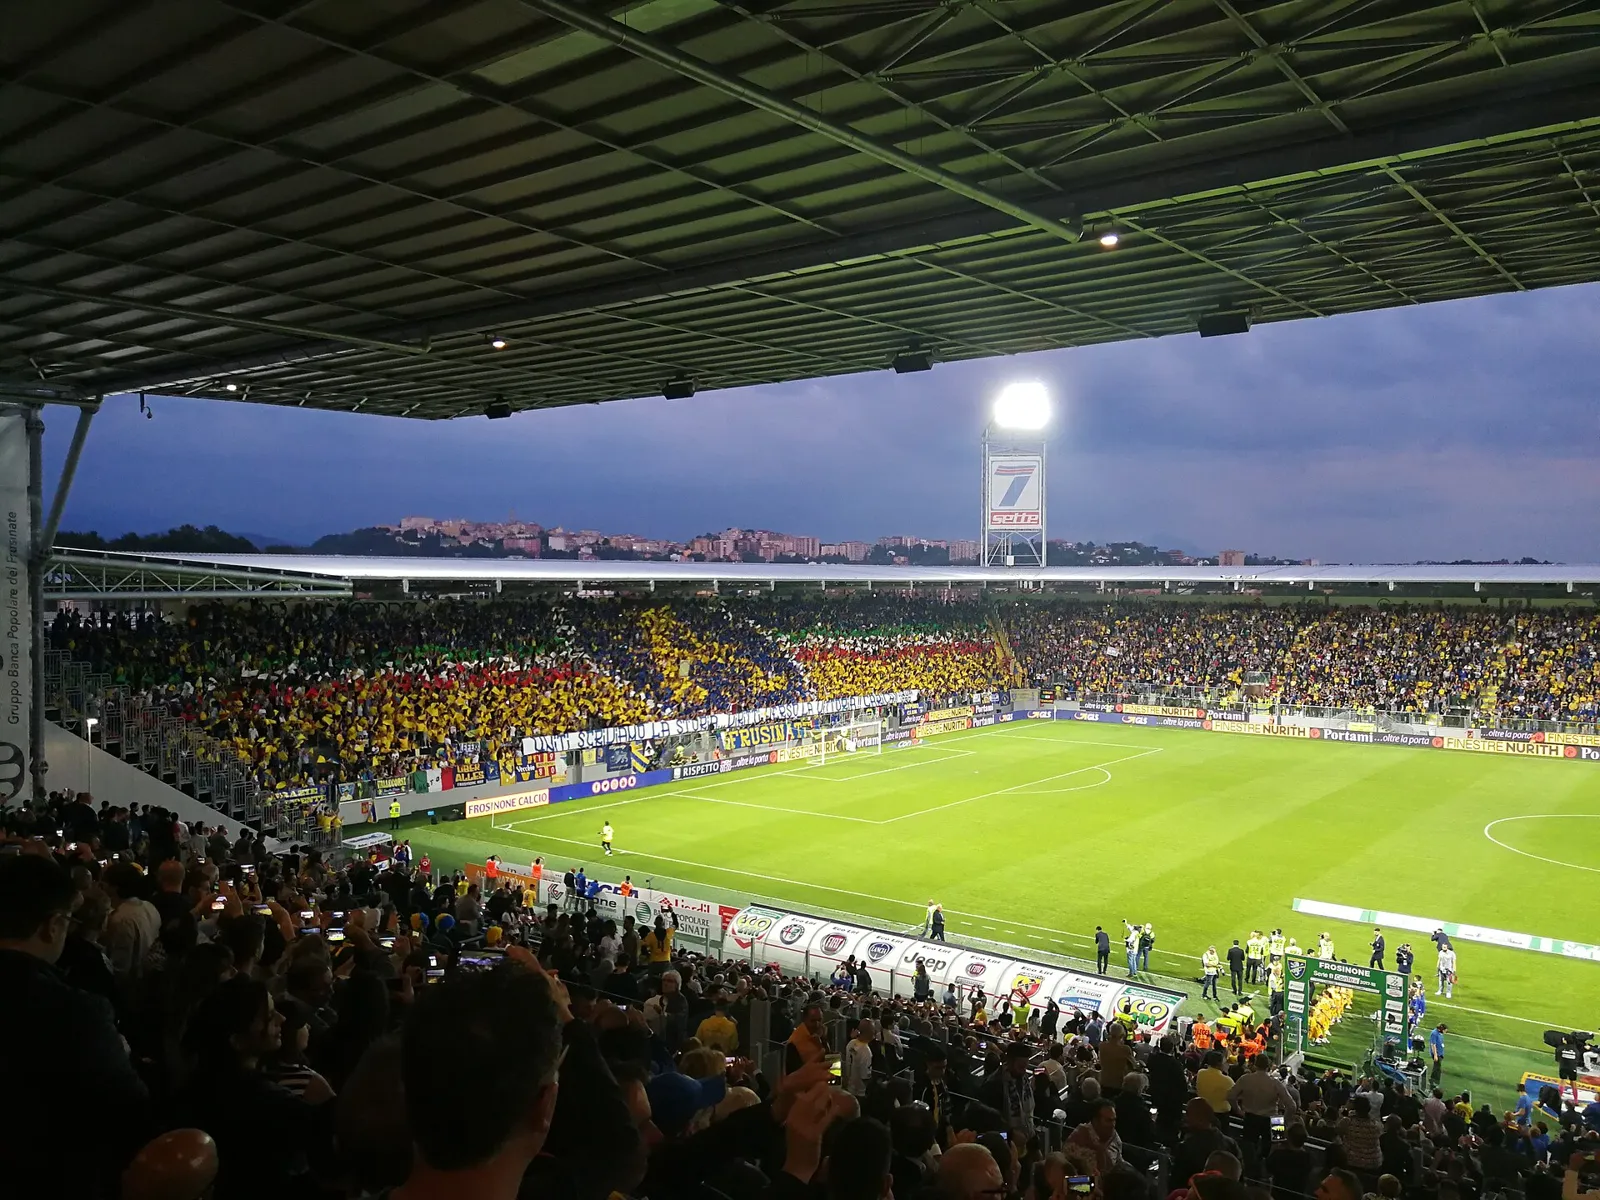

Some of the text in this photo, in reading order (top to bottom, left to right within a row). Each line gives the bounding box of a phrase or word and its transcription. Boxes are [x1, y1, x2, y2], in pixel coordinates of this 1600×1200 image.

[991, 513, 1039, 524] sette
[6, 511, 21, 725] Gruppo Banca Popolare del Frusinate
[1125, 704, 1194, 717] FINESTRE NURITH
[1207, 709, 1245, 721] Portami
[652, 721, 670, 739] LA
[676, 715, 718, 733] STORIA
[943, 719, 966, 732] NURITH
[1214, 721, 1306, 737] FINESTRE NURITH
[1324, 729, 1374, 743] Portami
[1401, 735, 1408, 744] la
[1408, 737, 1430, 747] porta
[1505, 730, 1512, 738] la
[1512, 732, 1532, 740] porta
[1548, 733, 1600, 745] FINESTRE
[1447, 738, 1559, 756] FINESTRE NURITH
[682, 761, 720, 777] RISPETTO
[468, 792, 548, 815] FROSINONE CALCIO
[904, 952, 947, 972] Jeep
[1319, 962, 1371, 977] FROSINONE
[1313, 970, 1328, 978] Serie
